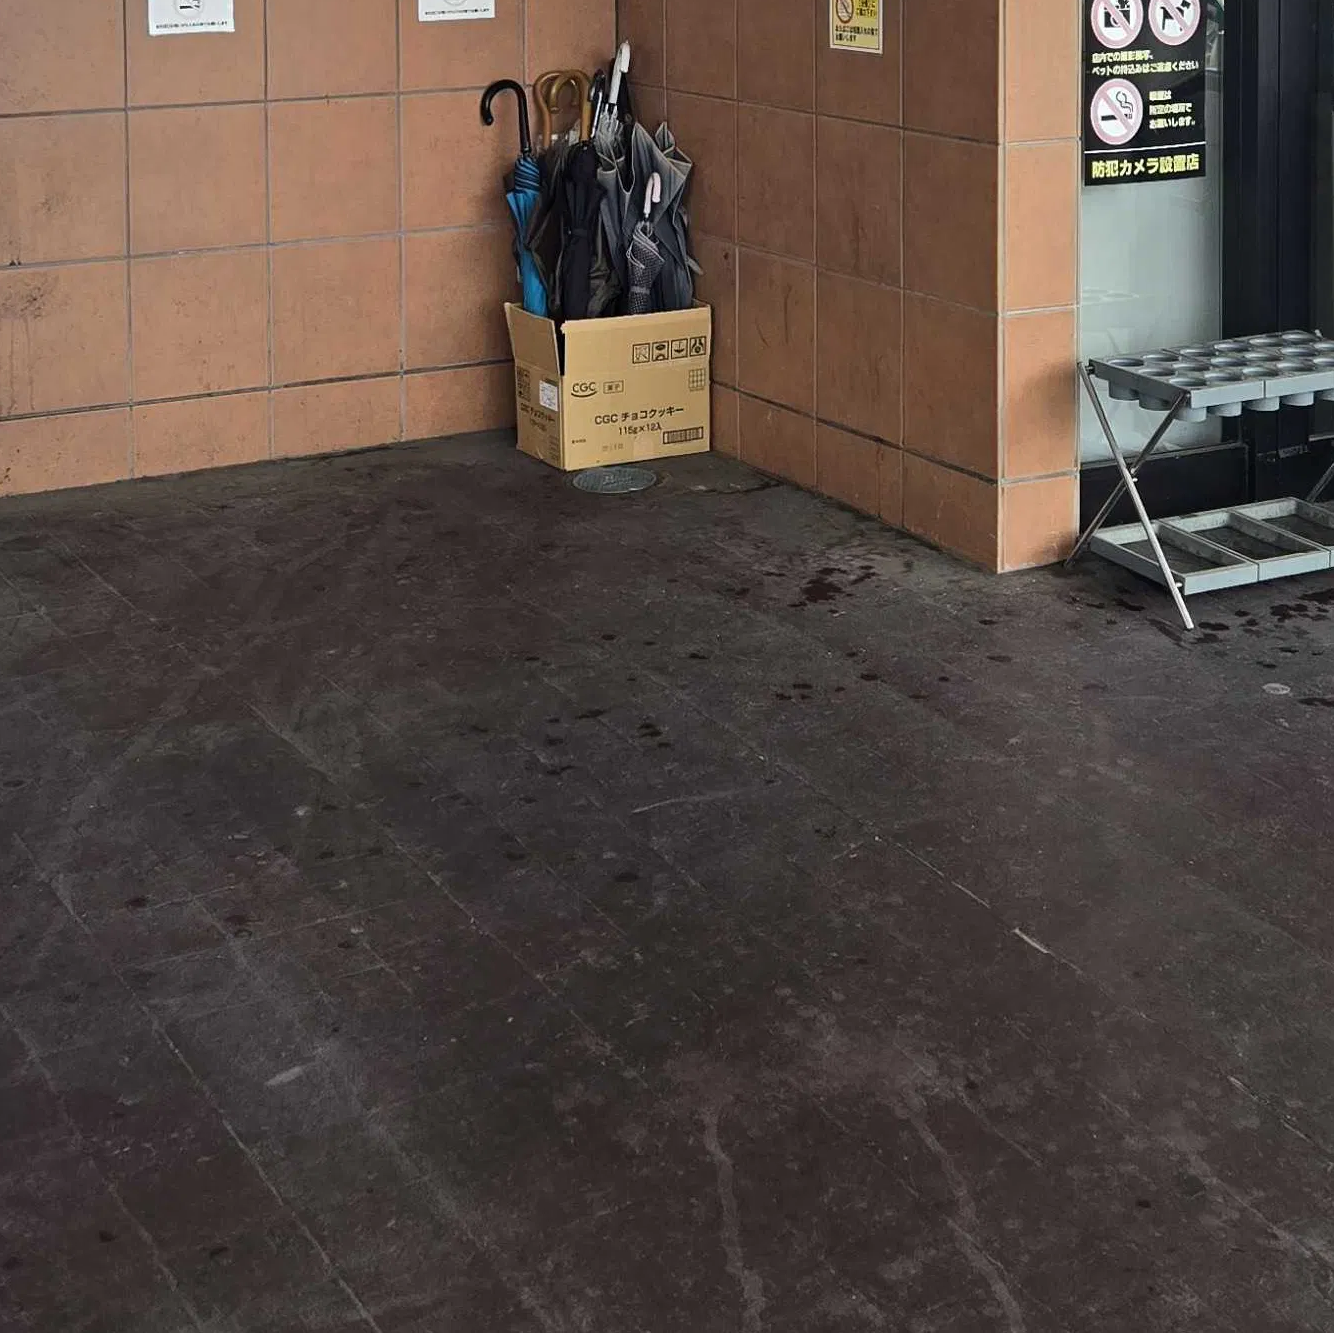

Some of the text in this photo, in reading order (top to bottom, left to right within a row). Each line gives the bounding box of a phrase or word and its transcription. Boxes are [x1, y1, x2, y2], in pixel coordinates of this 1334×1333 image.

[1091, 153, 1200, 179] 防犯カメラ設置店
[572, 381, 597, 393] CGC
[594, 406, 685, 426] CGC チョコクッキー
